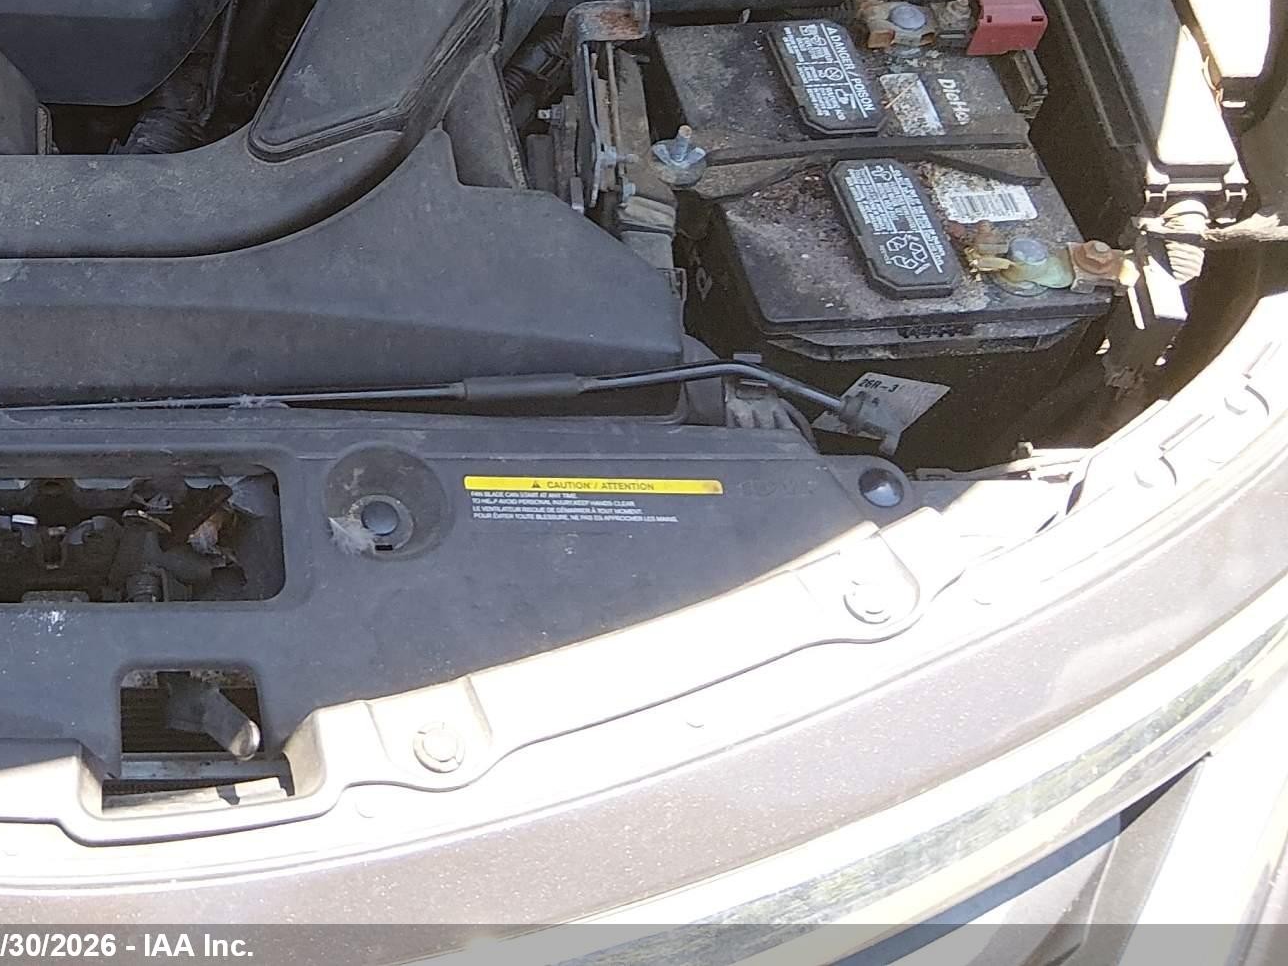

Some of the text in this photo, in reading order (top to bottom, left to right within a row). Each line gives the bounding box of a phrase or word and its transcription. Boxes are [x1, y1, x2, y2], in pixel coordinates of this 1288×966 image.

[831, 36, 856, 70] DANGER
[851, 77, 876, 111] POISON
[546, 481, 590, 489] CAUTION
[601, 482, 655, 491] ATTENTION
